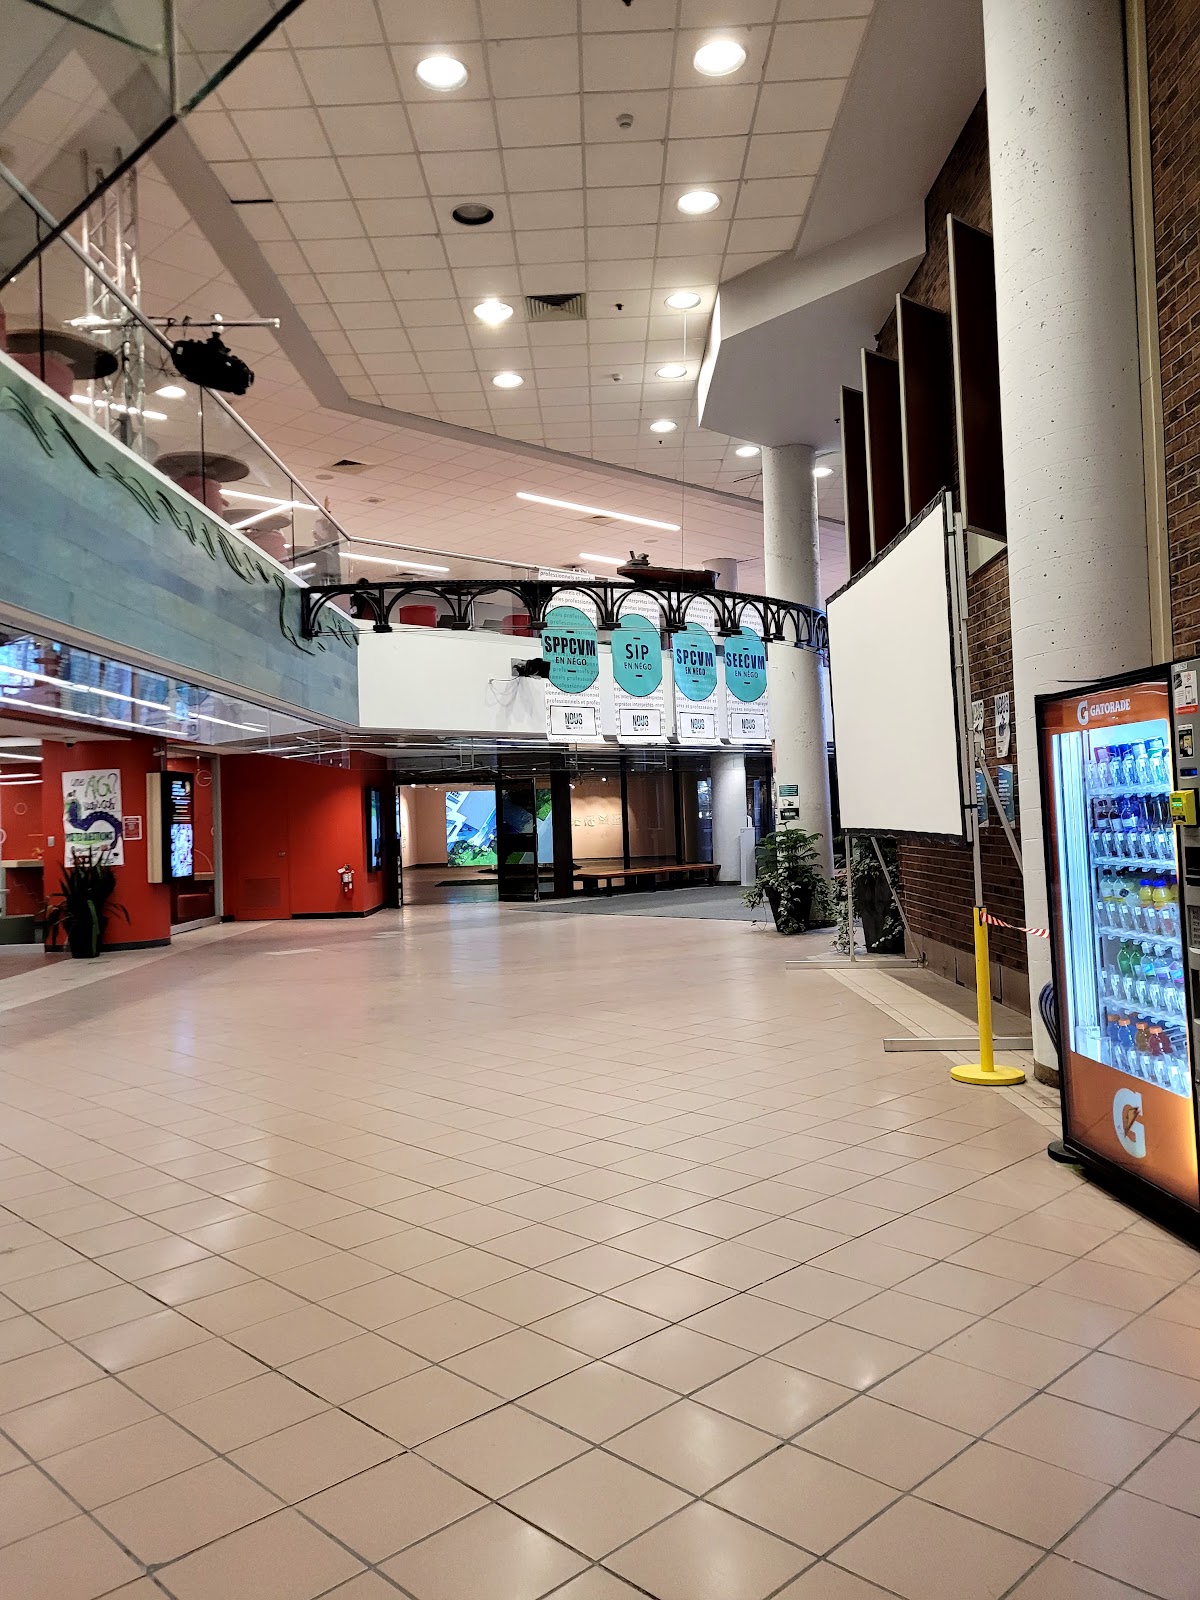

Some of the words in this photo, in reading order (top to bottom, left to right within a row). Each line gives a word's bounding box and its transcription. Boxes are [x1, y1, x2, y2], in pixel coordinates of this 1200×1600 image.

[544, 636, 596, 656] SPPCVM
[626, 644, 648, 660] SIP
[567, 656, 586, 665] NÉGO
[677, 649, 713, 667] SPCVM
[726, 653, 764, 669] SEECVM
[634, 662, 652, 670] NÉGO
[1090, 699, 1131, 716] GATORADE
[565, 712, 582, 724] NOUS
[633, 715, 648, 726] NOUS
[691, 719, 705, 729] NOUS
[742, 719, 755, 729] NOUS
